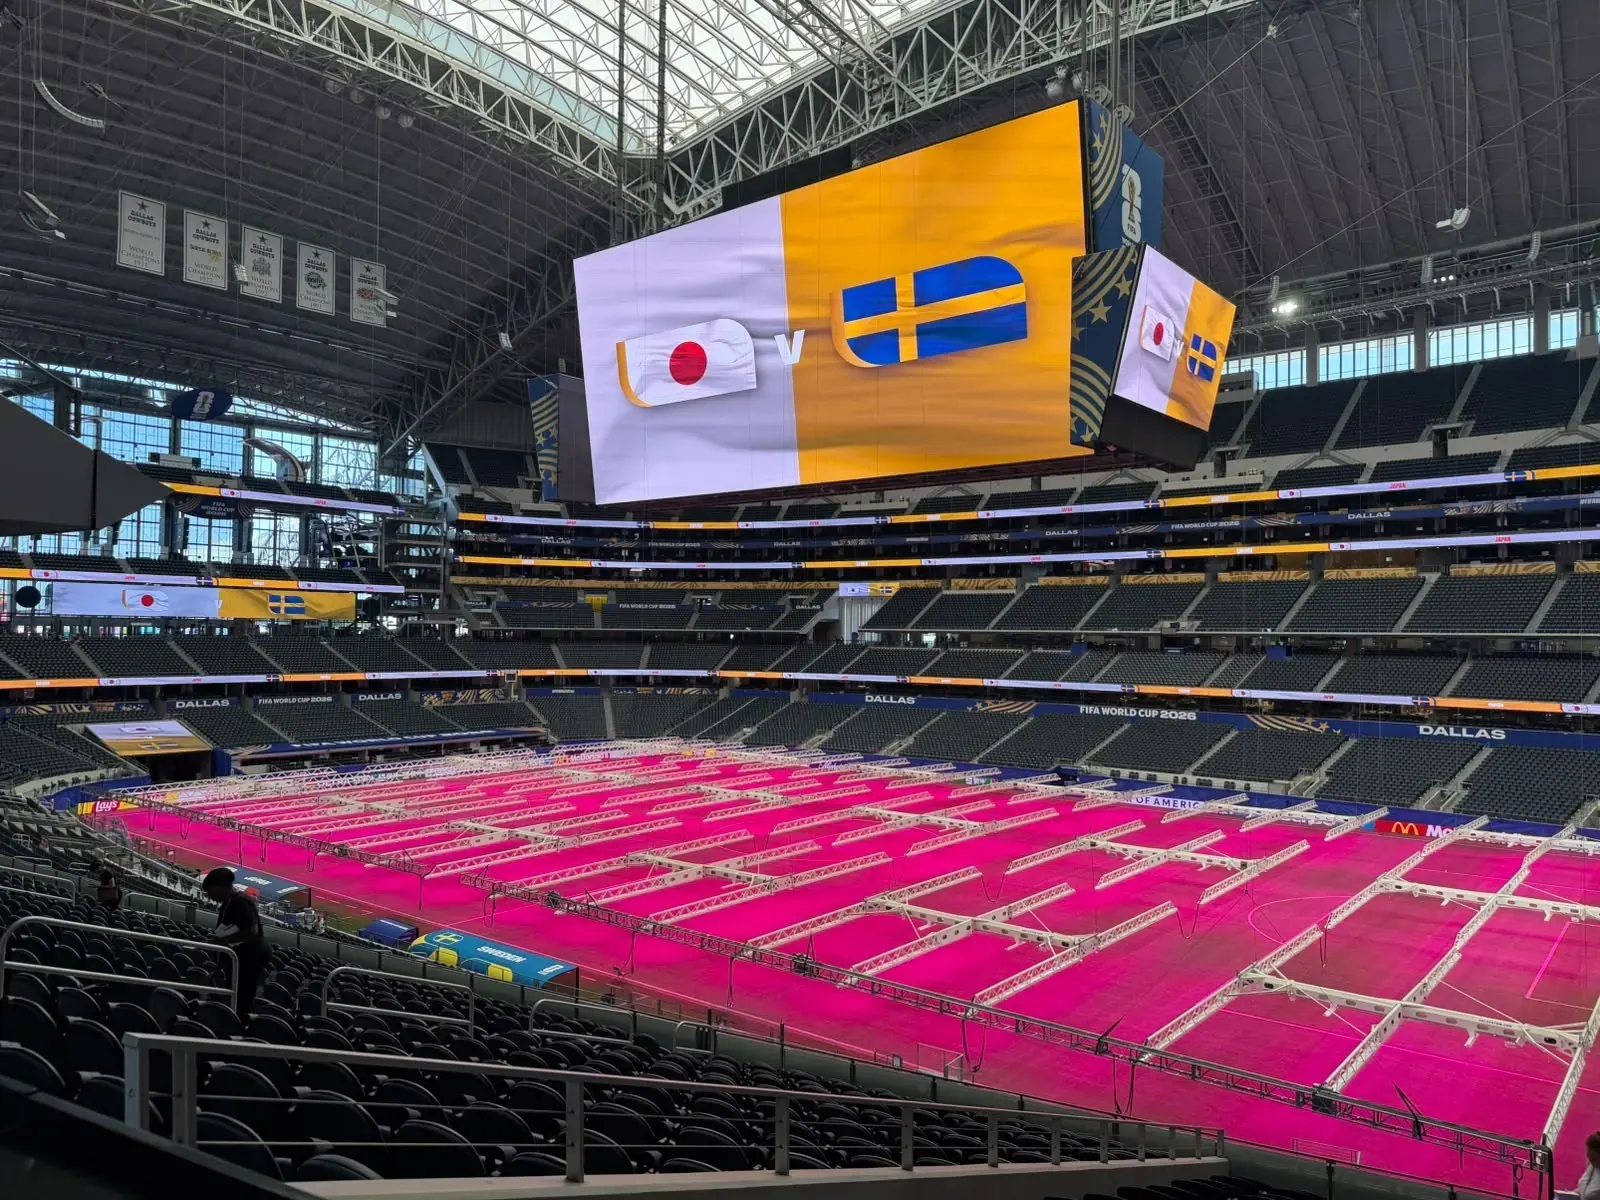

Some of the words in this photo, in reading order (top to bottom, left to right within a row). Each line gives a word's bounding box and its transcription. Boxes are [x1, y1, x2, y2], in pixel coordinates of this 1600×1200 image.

[130, 210, 154, 221] DALLAS
[128, 216, 156, 228] COWBOYS
[196, 228, 217, 238] DALLAS
[1128, 223, 1137, 236] FIFA
[192, 234, 220, 244] COWBOYS
[128, 244, 154, 256] WORLD
[250, 248, 274, 258] COWBOYS
[252, 244, 272, 252] DALLAS
[304, 263, 328, 272] COWBOYS
[307, 258, 326, 267] DALLAS
[1348, 512, 1391, 520] DALLAS
[358, 693, 402, 701] DALLAS
[865, 695, 916, 705] DALLAS
[176, 699, 230, 708] DALLAS
[1080, 706, 1100, 715] FIFA
[1102, 707, 1136, 717] WORLD
[1138, 709, 1159, 718] CUP
[1160, 710, 1197, 720] 2026
[1418, 725, 1506, 740] DALLAS
[1136, 796, 1150, 805] OF
[1153, 798, 1201, 810] AMERIC
[476, 946, 527, 963] SWEDEN
